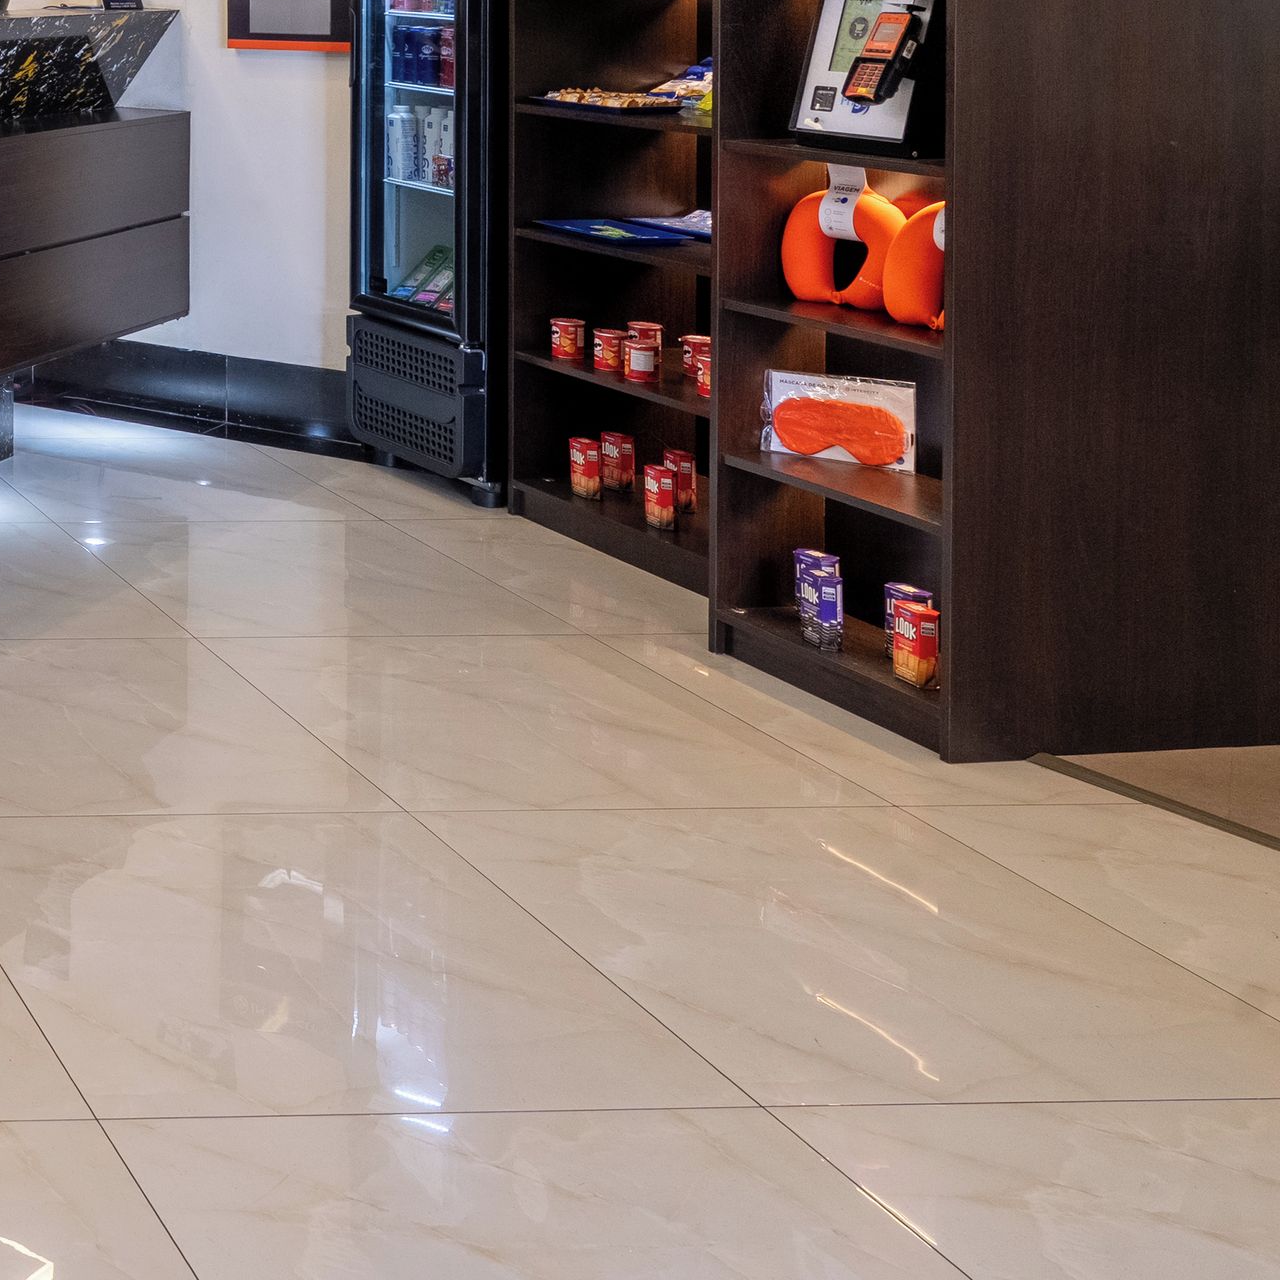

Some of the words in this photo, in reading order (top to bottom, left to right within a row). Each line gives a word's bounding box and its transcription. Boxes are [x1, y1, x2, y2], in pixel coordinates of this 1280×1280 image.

[833, 185, 861, 194] VIAGEM
[570, 448, 586, 466] LOOK
[601, 441, 620, 459] LOOK
[644, 476, 659, 494] LOOK
[801, 582, 819, 605] LOOK
[895, 616, 917, 641] LOOK
